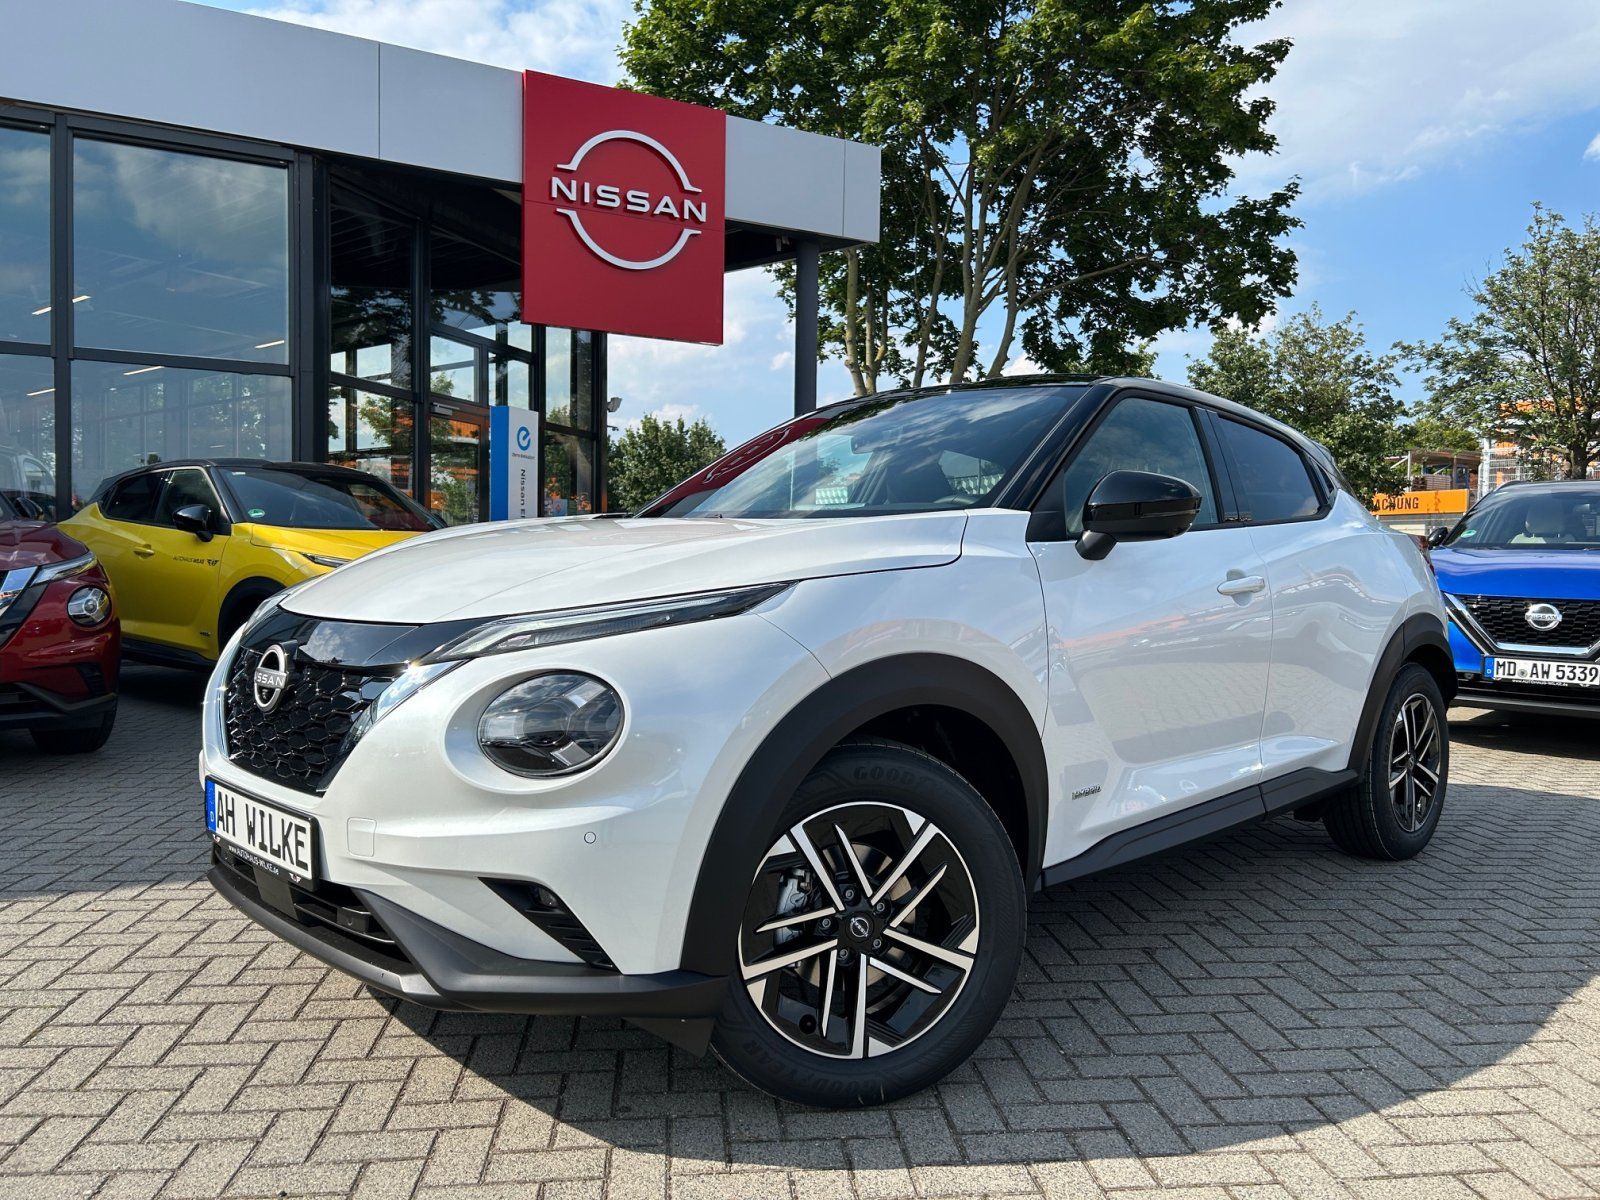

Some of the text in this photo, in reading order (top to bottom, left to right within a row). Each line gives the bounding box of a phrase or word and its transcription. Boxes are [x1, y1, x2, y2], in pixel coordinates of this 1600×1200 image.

[551, 176, 707, 223] NISSAN
[1496, 660, 1517, 677] MD
[1529, 662, 1552, 680] AW
[1555, 664, 1599, 683] 5339
[216, 791, 236, 838] AH
[245, 803, 309, 872] WILKE
